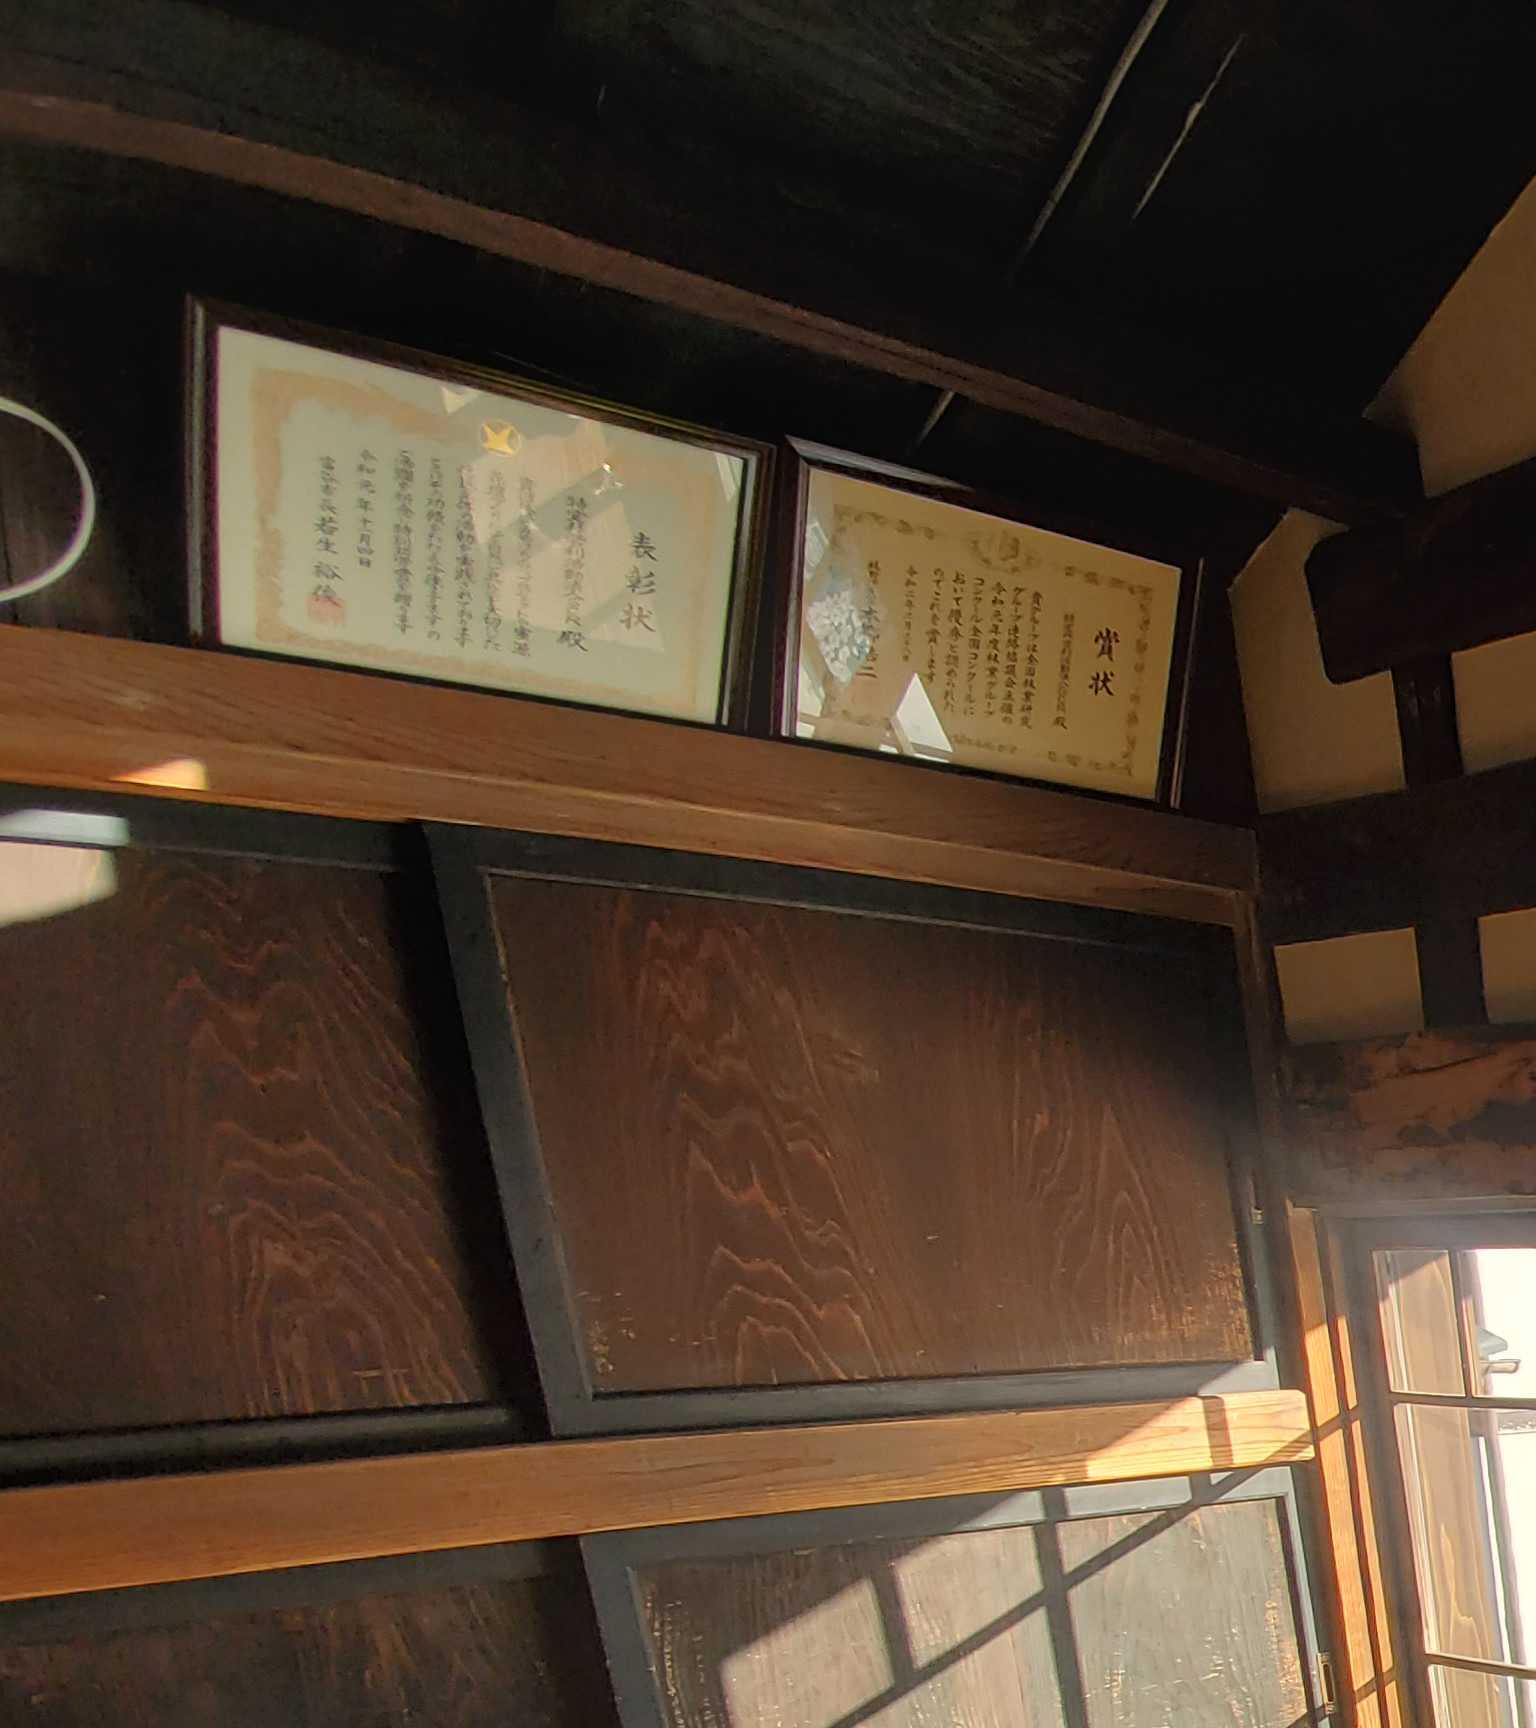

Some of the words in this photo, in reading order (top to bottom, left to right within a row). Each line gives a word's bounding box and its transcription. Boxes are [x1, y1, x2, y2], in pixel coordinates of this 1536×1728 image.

[618, 531, 660, 633] 表彰状
[1088, 627, 1120, 697] 賞状
